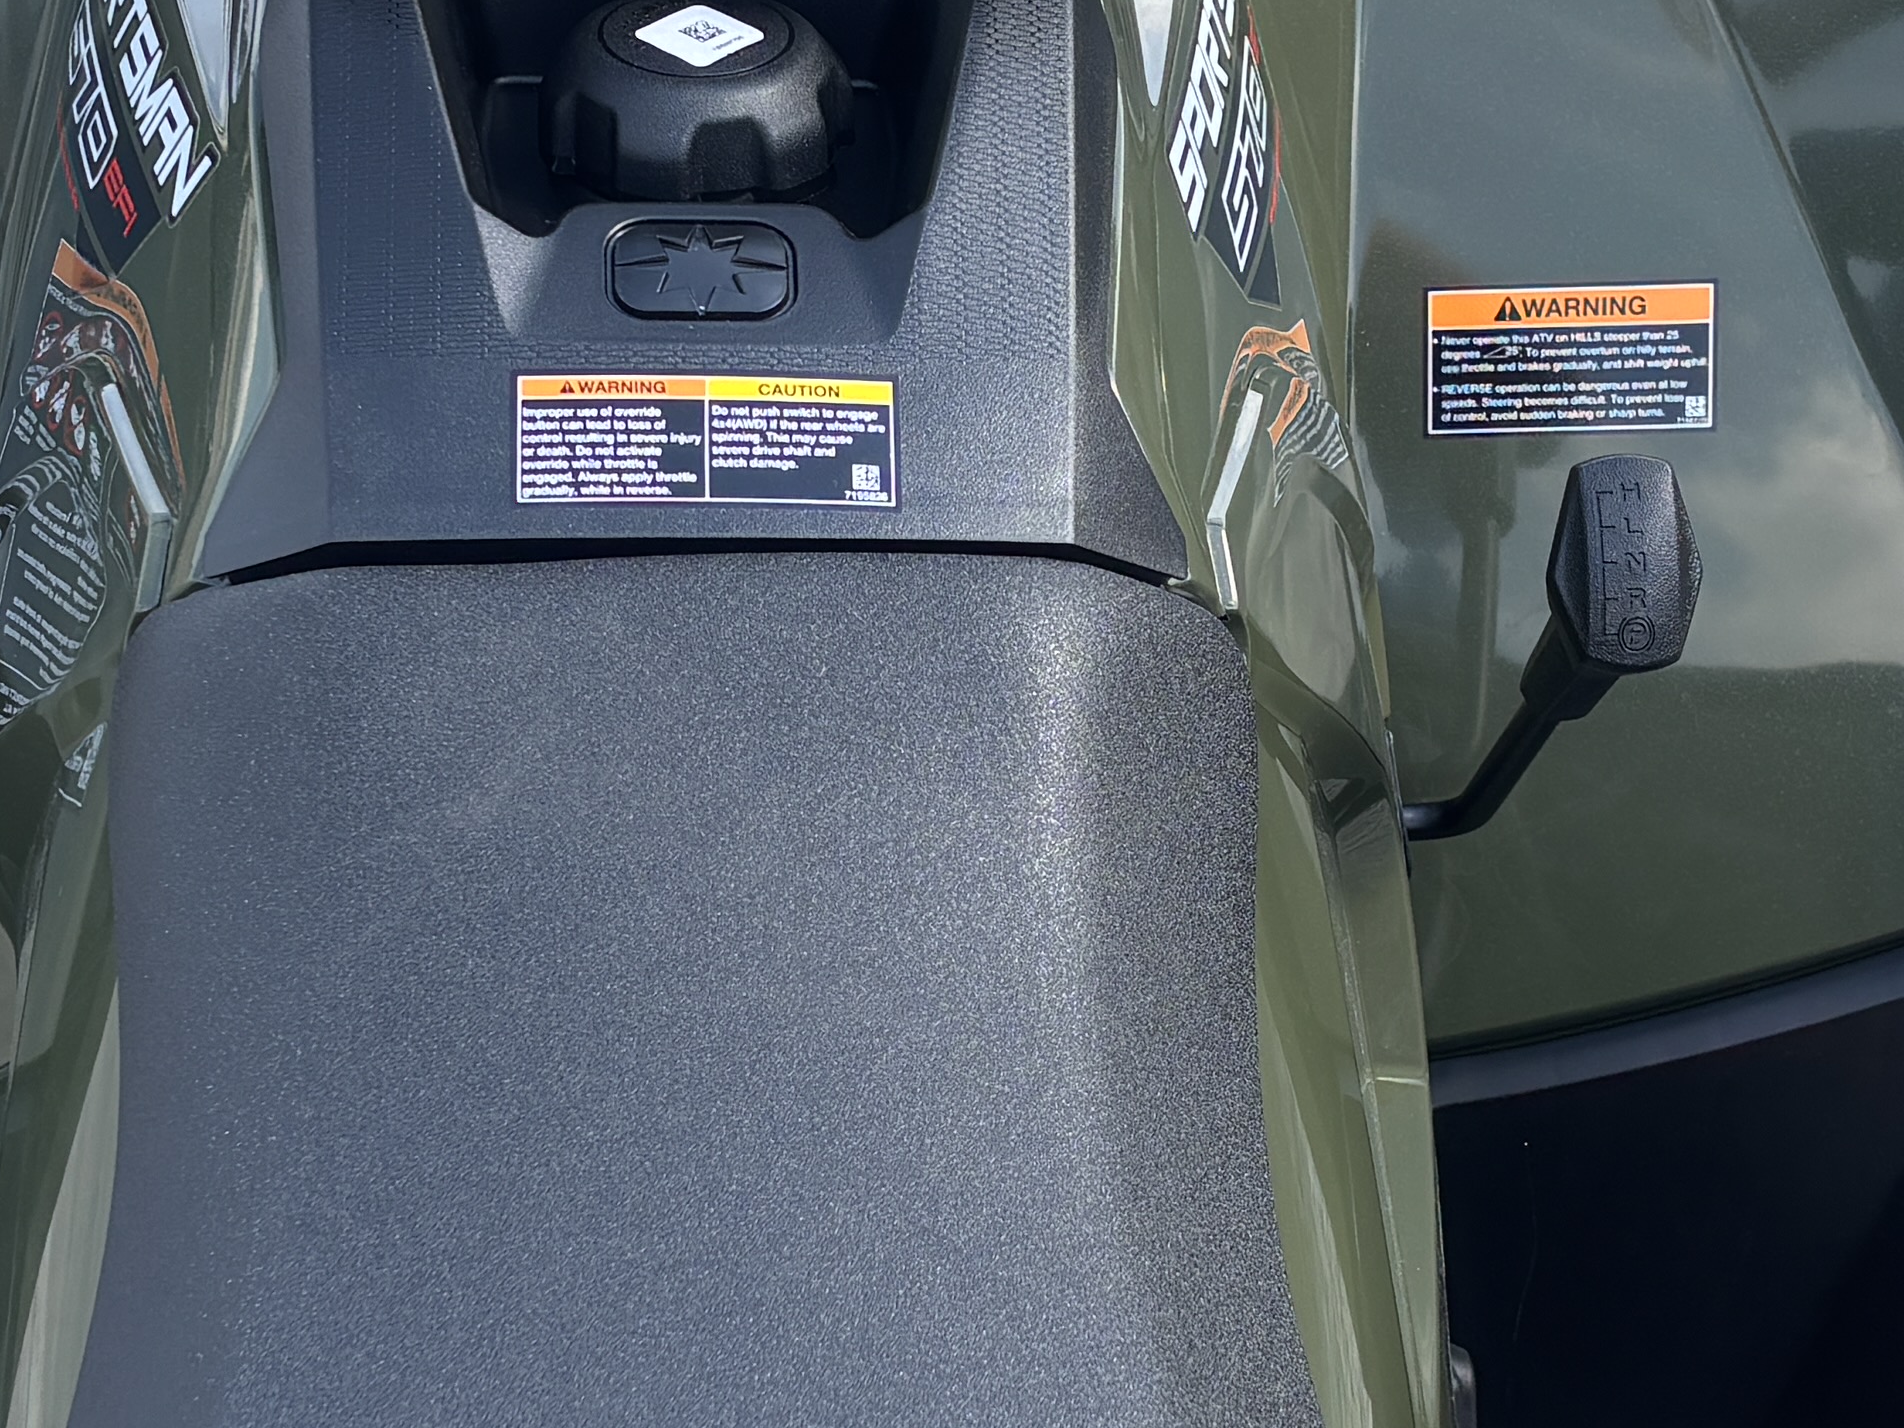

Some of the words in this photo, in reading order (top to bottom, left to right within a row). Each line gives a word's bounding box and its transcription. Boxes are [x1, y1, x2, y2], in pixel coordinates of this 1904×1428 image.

[1521, 295, 1647, 318] WARNING
[578, 380, 666, 394] WARNING
[758, 383, 840, 398] CAUTION
